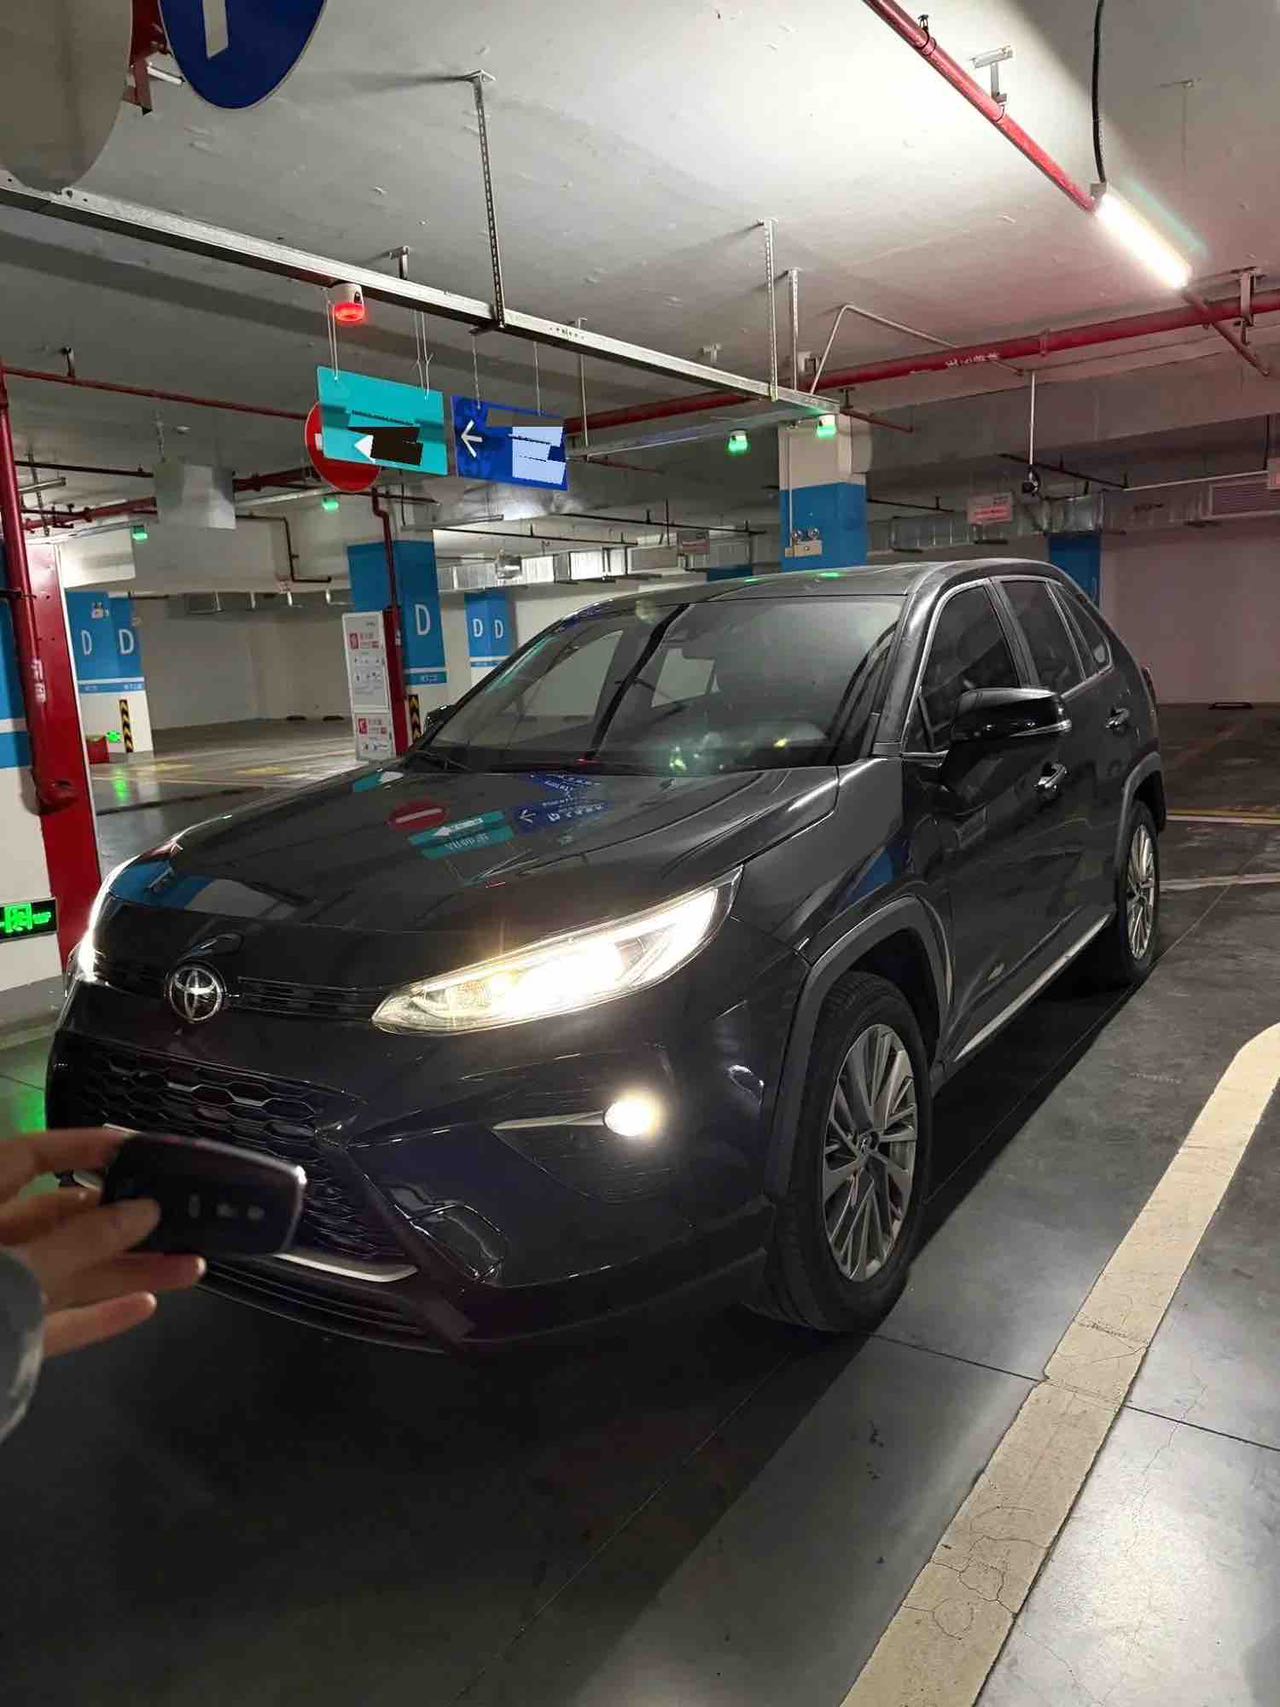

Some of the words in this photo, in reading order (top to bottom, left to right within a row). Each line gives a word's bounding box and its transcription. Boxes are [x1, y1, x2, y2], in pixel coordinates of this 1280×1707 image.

[415, 604, 431, 636] D
[473, 618, 484, 638] D
[494, 619, 504, 639] D
[82, 630, 92, 656] D
[119, 629, 134, 655] D
